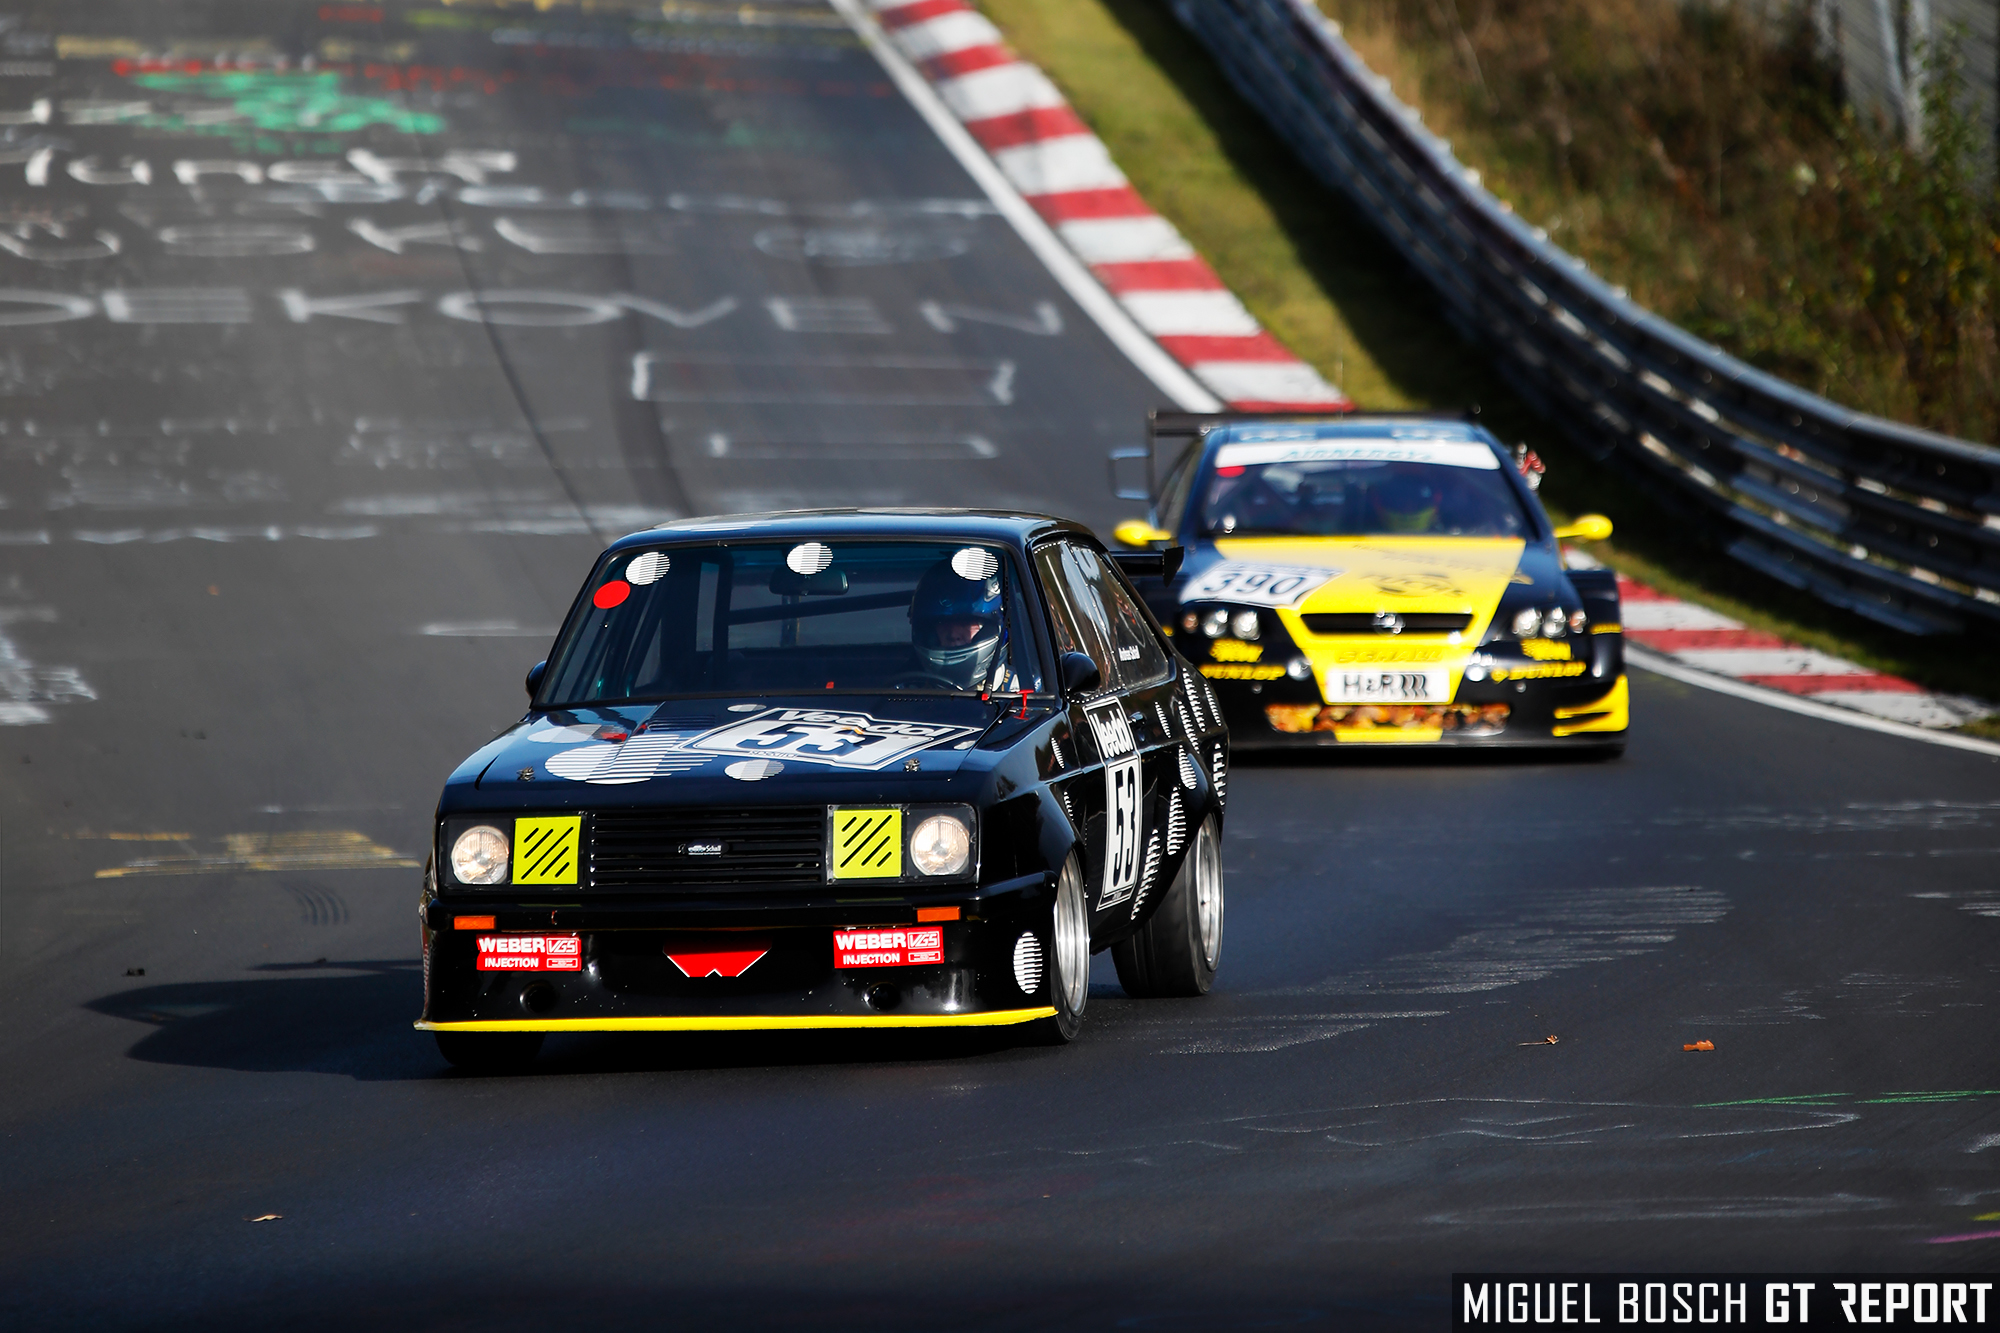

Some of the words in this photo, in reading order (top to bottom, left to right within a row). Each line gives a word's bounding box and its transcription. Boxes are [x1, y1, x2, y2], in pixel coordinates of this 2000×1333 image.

[1203, 573, 1306, 595] 390
[778, 711, 955, 737] Veedol
[1089, 708, 1133, 759] Veedol
[736, 723, 887, 757] 53
[1112, 766, 1135, 887] 53
[479, 938, 545, 953] WEBER
[548, 939, 576, 953] VGS
[836, 933, 906, 950] WEBER
[909, 933, 939, 948] VGS
[485, 958, 539, 968] INJECTION
[843, 953, 900, 965] INJECTION
